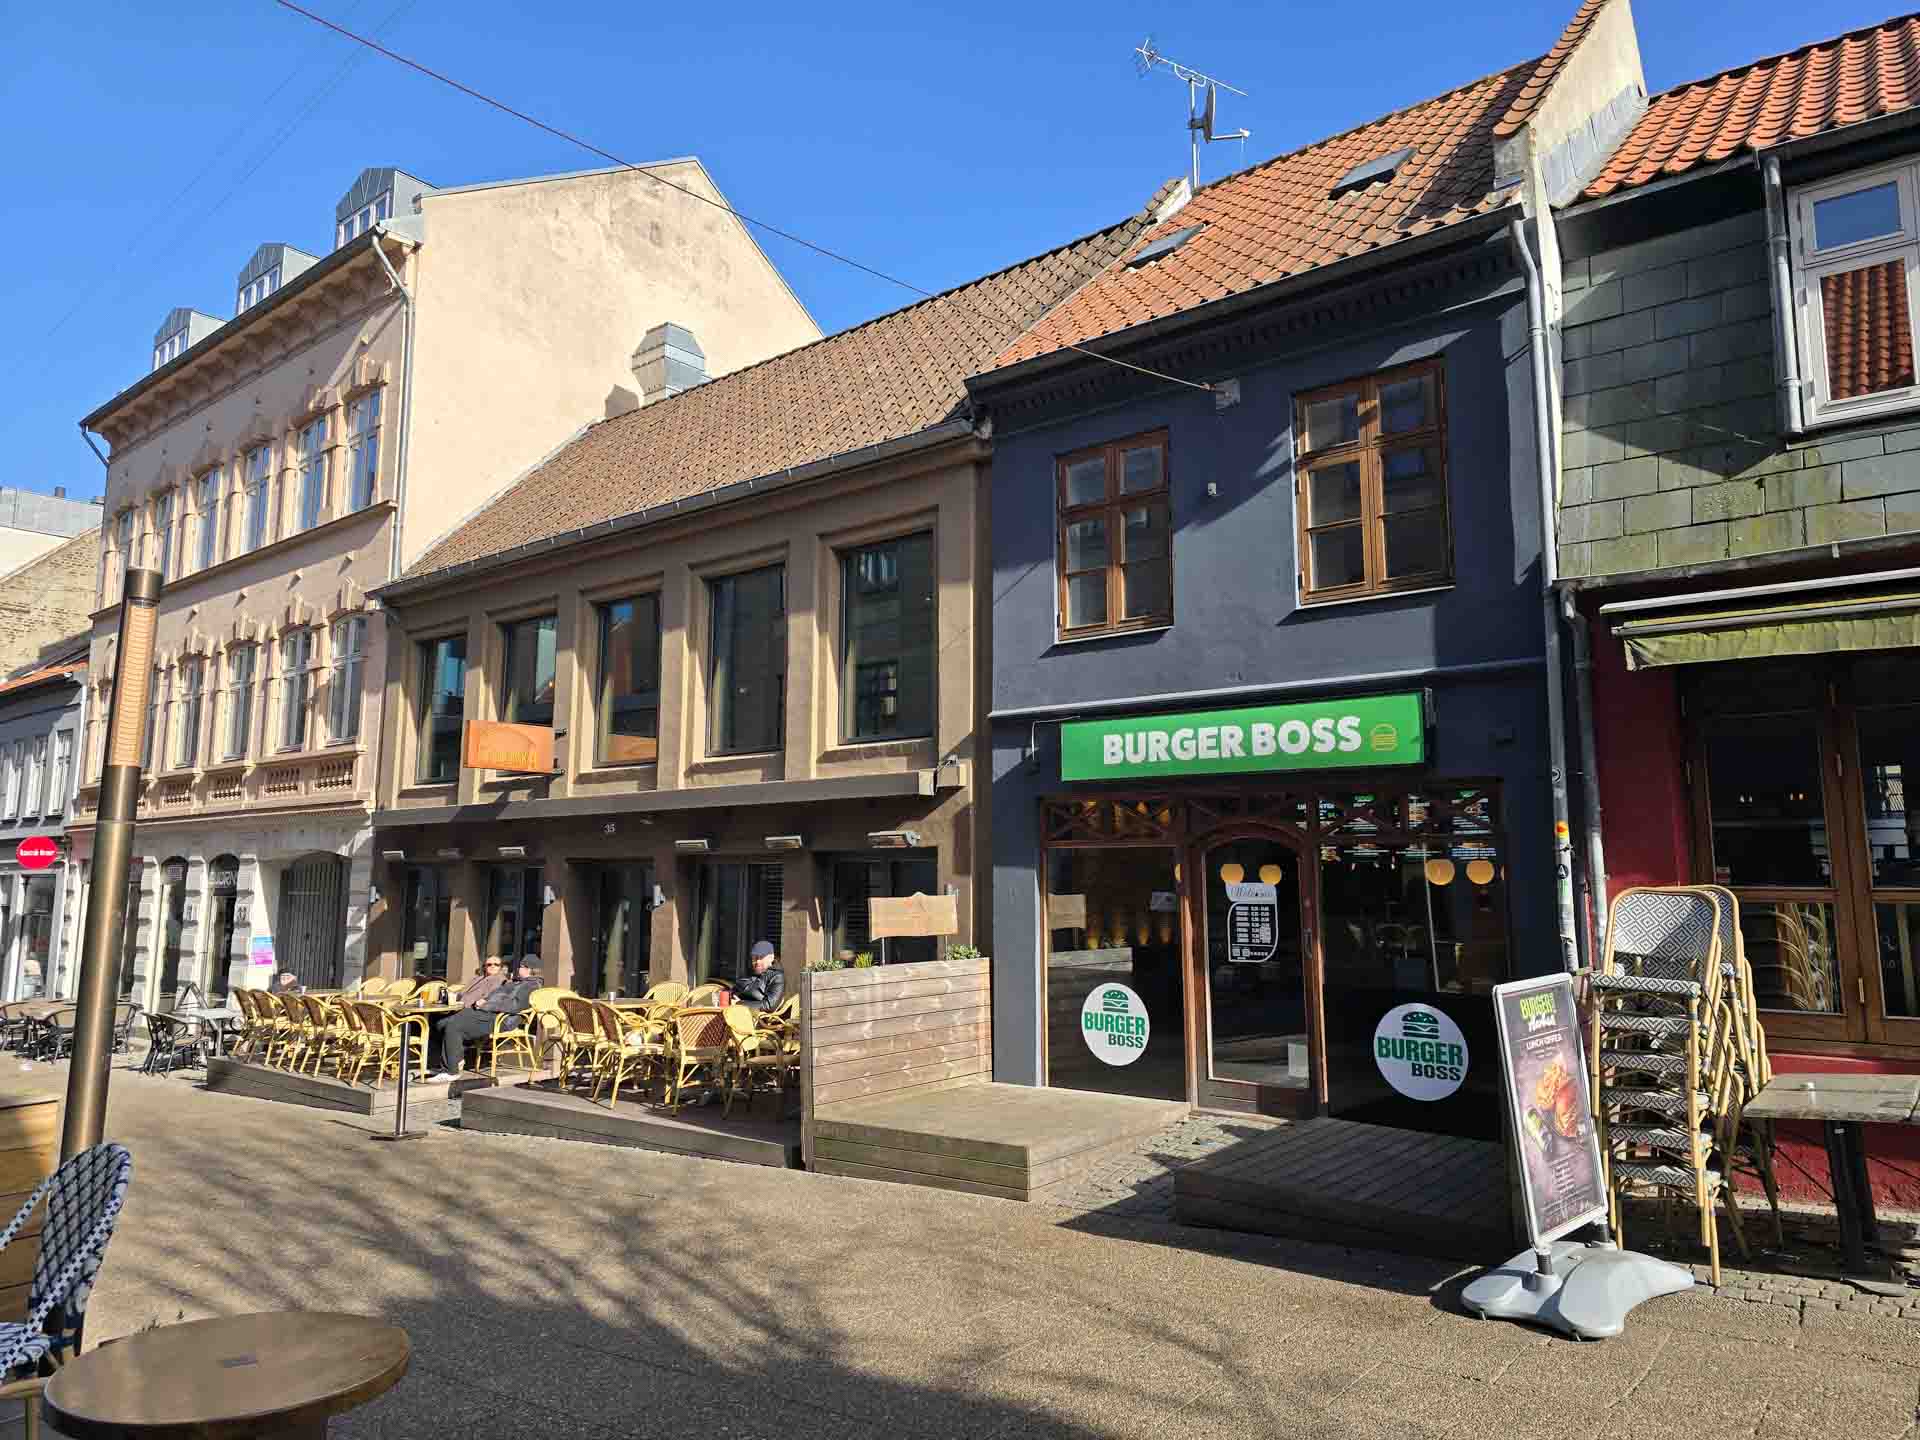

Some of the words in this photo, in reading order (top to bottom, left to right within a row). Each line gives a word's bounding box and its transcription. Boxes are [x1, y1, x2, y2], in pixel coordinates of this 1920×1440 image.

[1103, 725, 1245, 765] BURGER
[1251, 716, 1361, 757] BOSS
[1520, 993, 1553, 1019] BURGER
[1084, 1012, 1146, 1036] BURGER
[1108, 1033, 1144, 1049] BOSS
[1377, 1037, 1463, 1066] BURGER
[1412, 1063, 1461, 1081] BOSS
